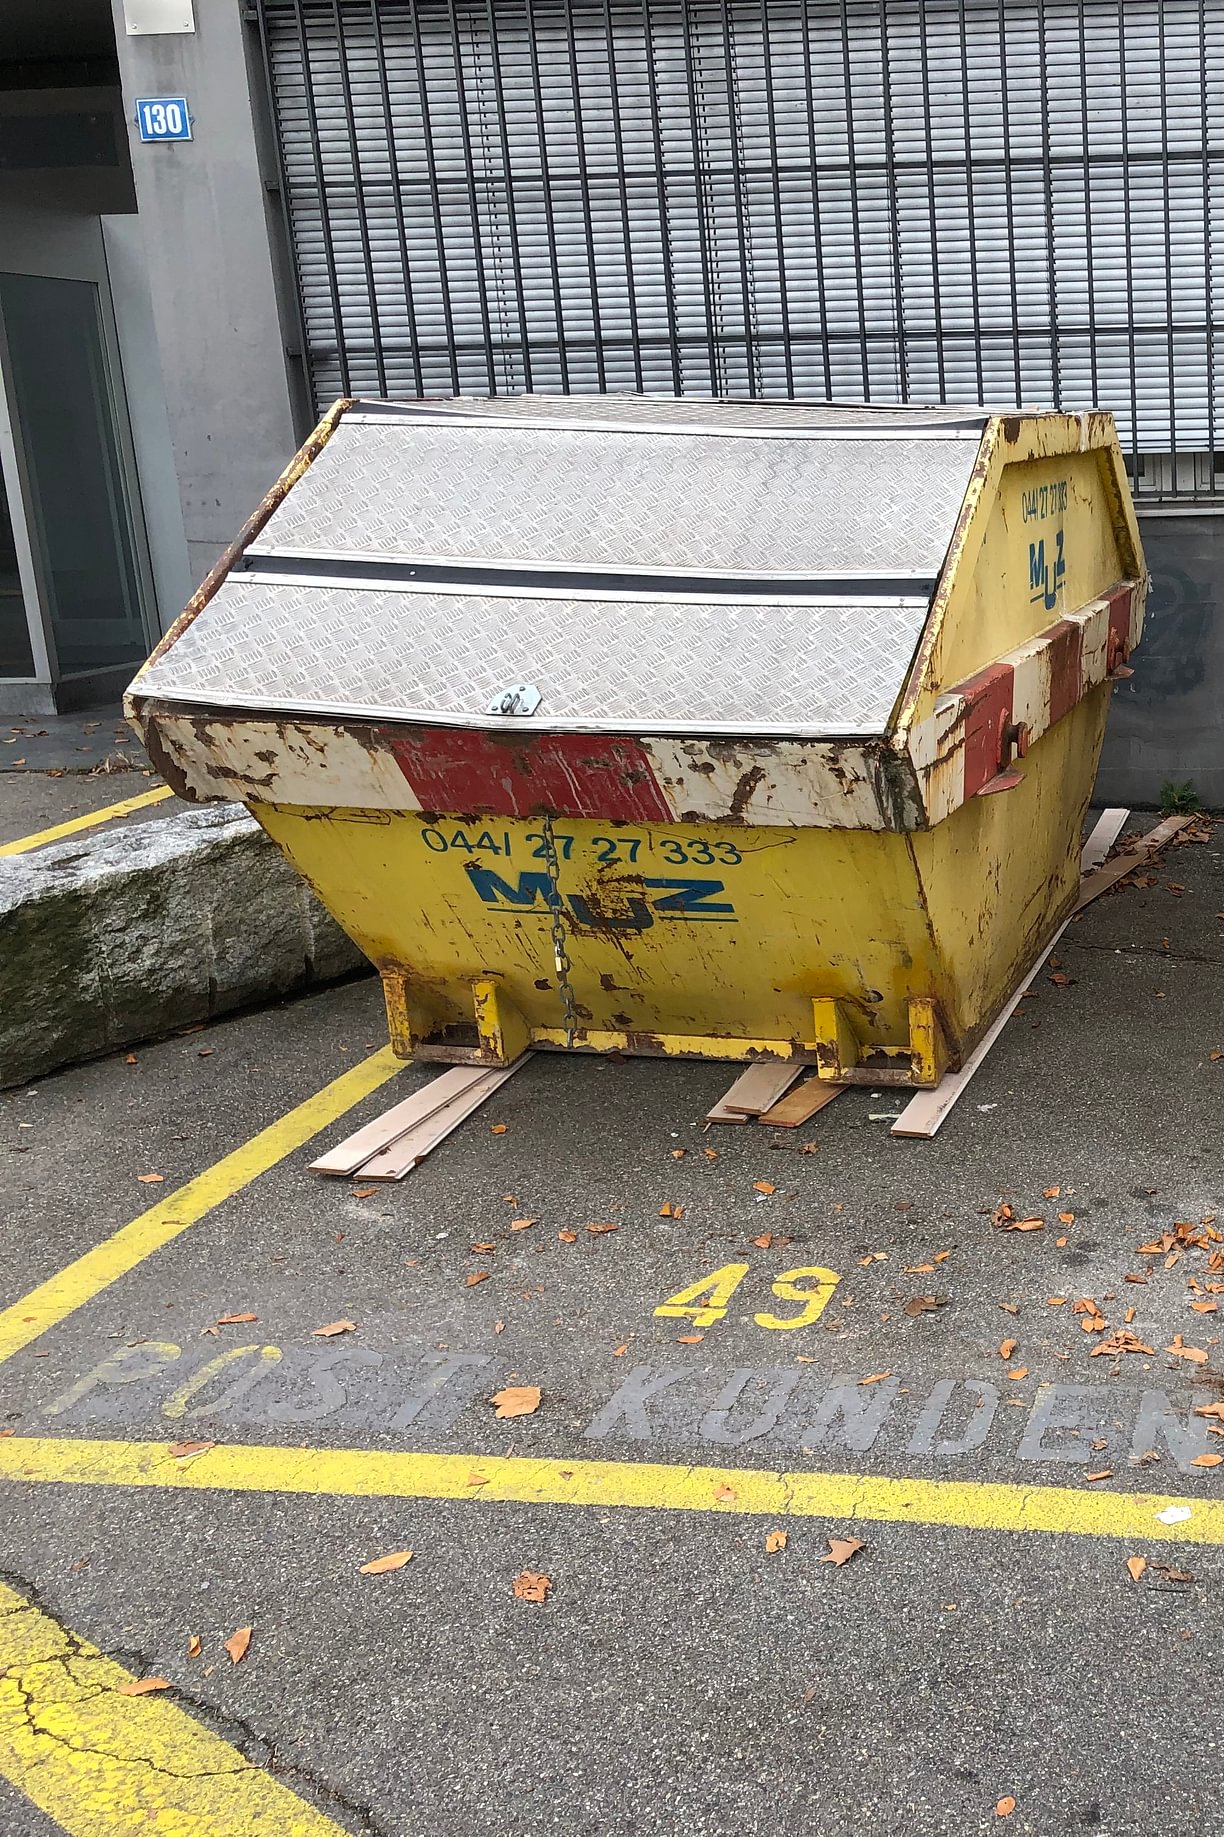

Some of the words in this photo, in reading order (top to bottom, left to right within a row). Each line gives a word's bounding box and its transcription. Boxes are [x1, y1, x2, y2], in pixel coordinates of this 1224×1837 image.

[143, 103, 182, 134] 130
[1029, 530, 1066, 610] MUZ
[525, 833, 575, 860] 27
[591, 836, 642, 863] 27
[659, 839, 743, 866] 333
[466, 868, 736, 930] MUZ
[652, 1263, 842, 1330] 49
[583, 1365, 1222, 1476] KUNDEN
